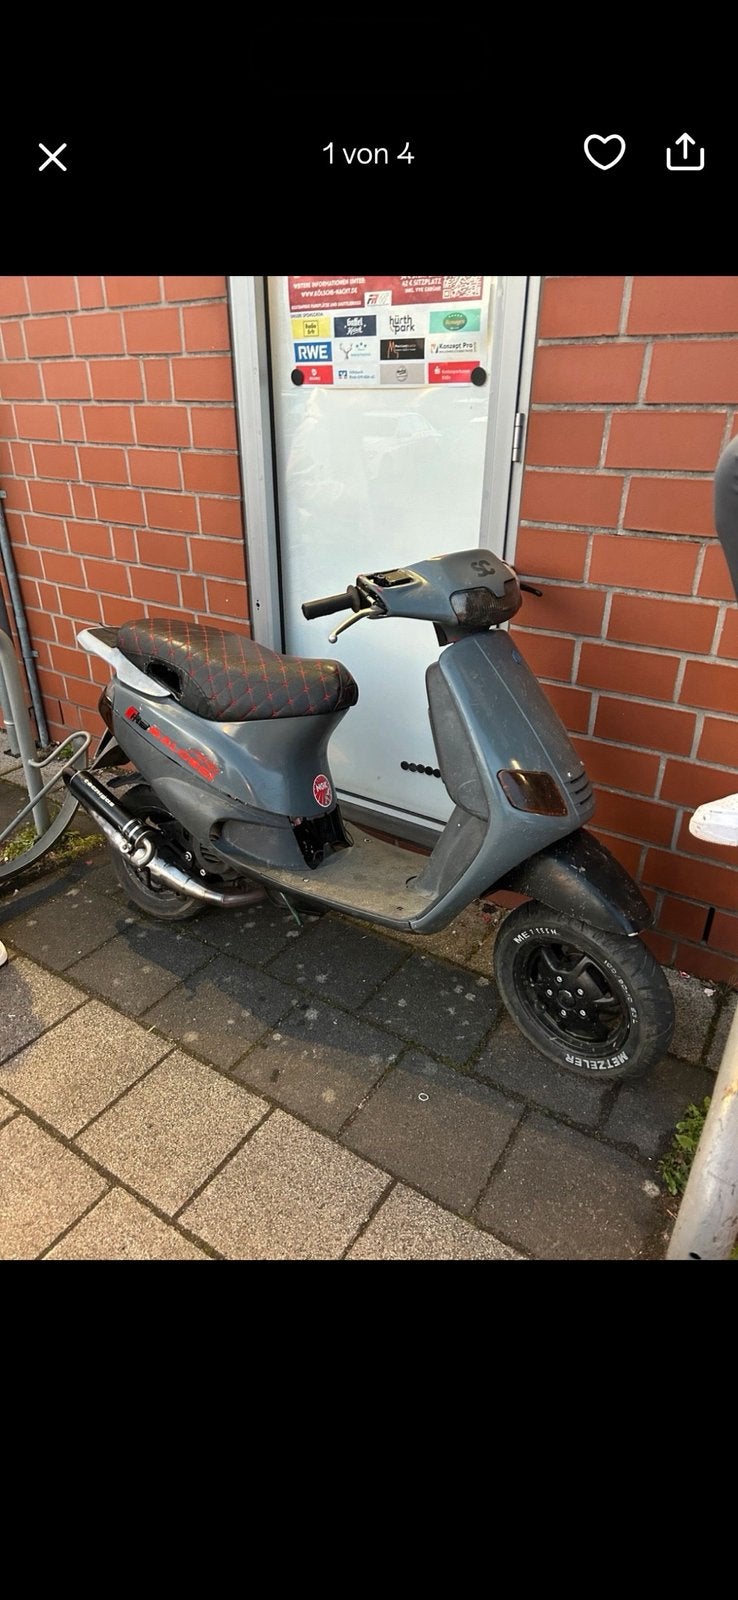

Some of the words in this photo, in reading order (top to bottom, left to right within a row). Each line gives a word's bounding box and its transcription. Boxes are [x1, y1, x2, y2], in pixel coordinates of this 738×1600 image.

[413, 278, 442, 286] SITZPLATZ
[389, 314, 413, 325] hürth
[393, 324, 415, 335] park
[297, 344, 329, 360] RWE
[439, 342, 461, 351] Konzept
[315, 781, 329, 792] NGK
[512, 930, 531, 944] ME
[565, 1050, 630, 1070] METZELER
